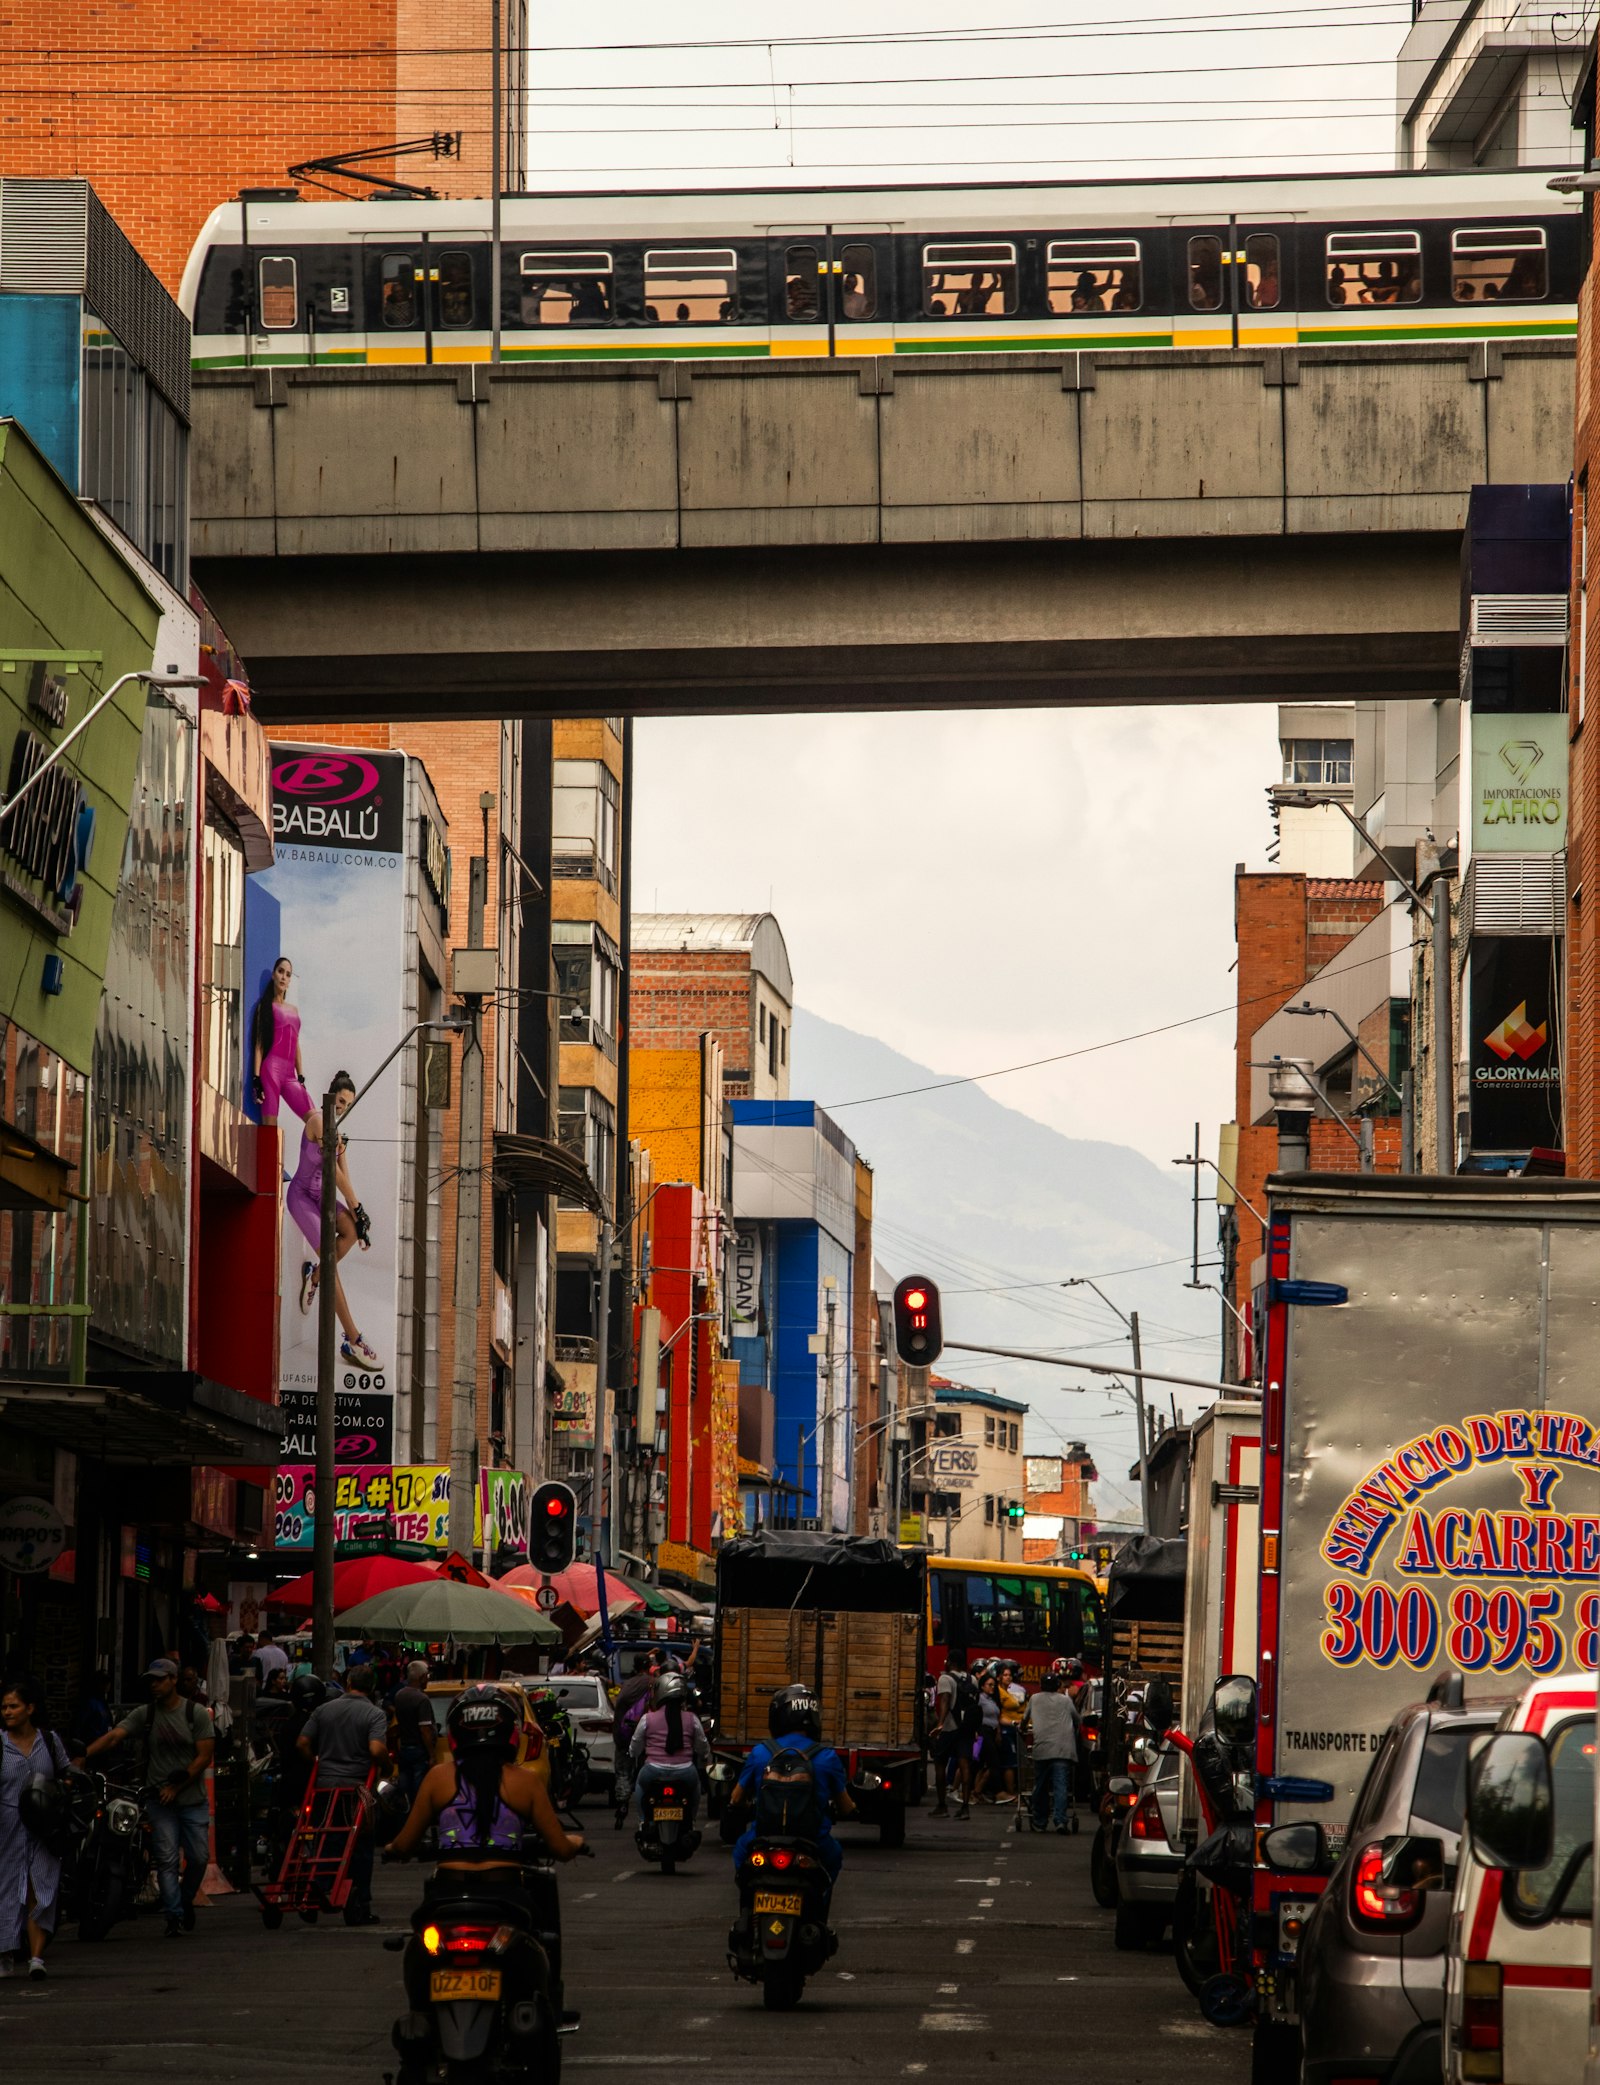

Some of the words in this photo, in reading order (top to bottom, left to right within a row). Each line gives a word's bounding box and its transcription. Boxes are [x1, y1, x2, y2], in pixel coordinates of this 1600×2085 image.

[1484, 788, 1561, 799] IMPORTACIONES
[272, 804, 379, 841] BABALÚ
[1483, 799, 1562, 824] ZAFIRO
[276, 848, 397, 869] W.BABALU.COM.CO
[1475, 1067, 1560, 1080] GLORYMAR
[737, 1235, 755, 1309] GILDAN
[280, 1374, 317, 1384] UFASHI
[335, 1475, 362, 1508] EL
[1324, 1427, 1467, 1571] SERVICIO
[1468, 1412, 1528, 1457] DE
[1517, 1465, 1554, 1505] Y
[344, 1542, 363, 1551] Calle
[367, 1541, 378, 1550] 46
[1400, 1510, 1599, 1574] ACARRE
[1324, 1583, 1432, 1662] 300
[1450, 1587, 1556, 1668] 895
[462, 1706, 499, 1723] TPV22F
[1286, 1731, 1367, 1752] TRANSPORTE
